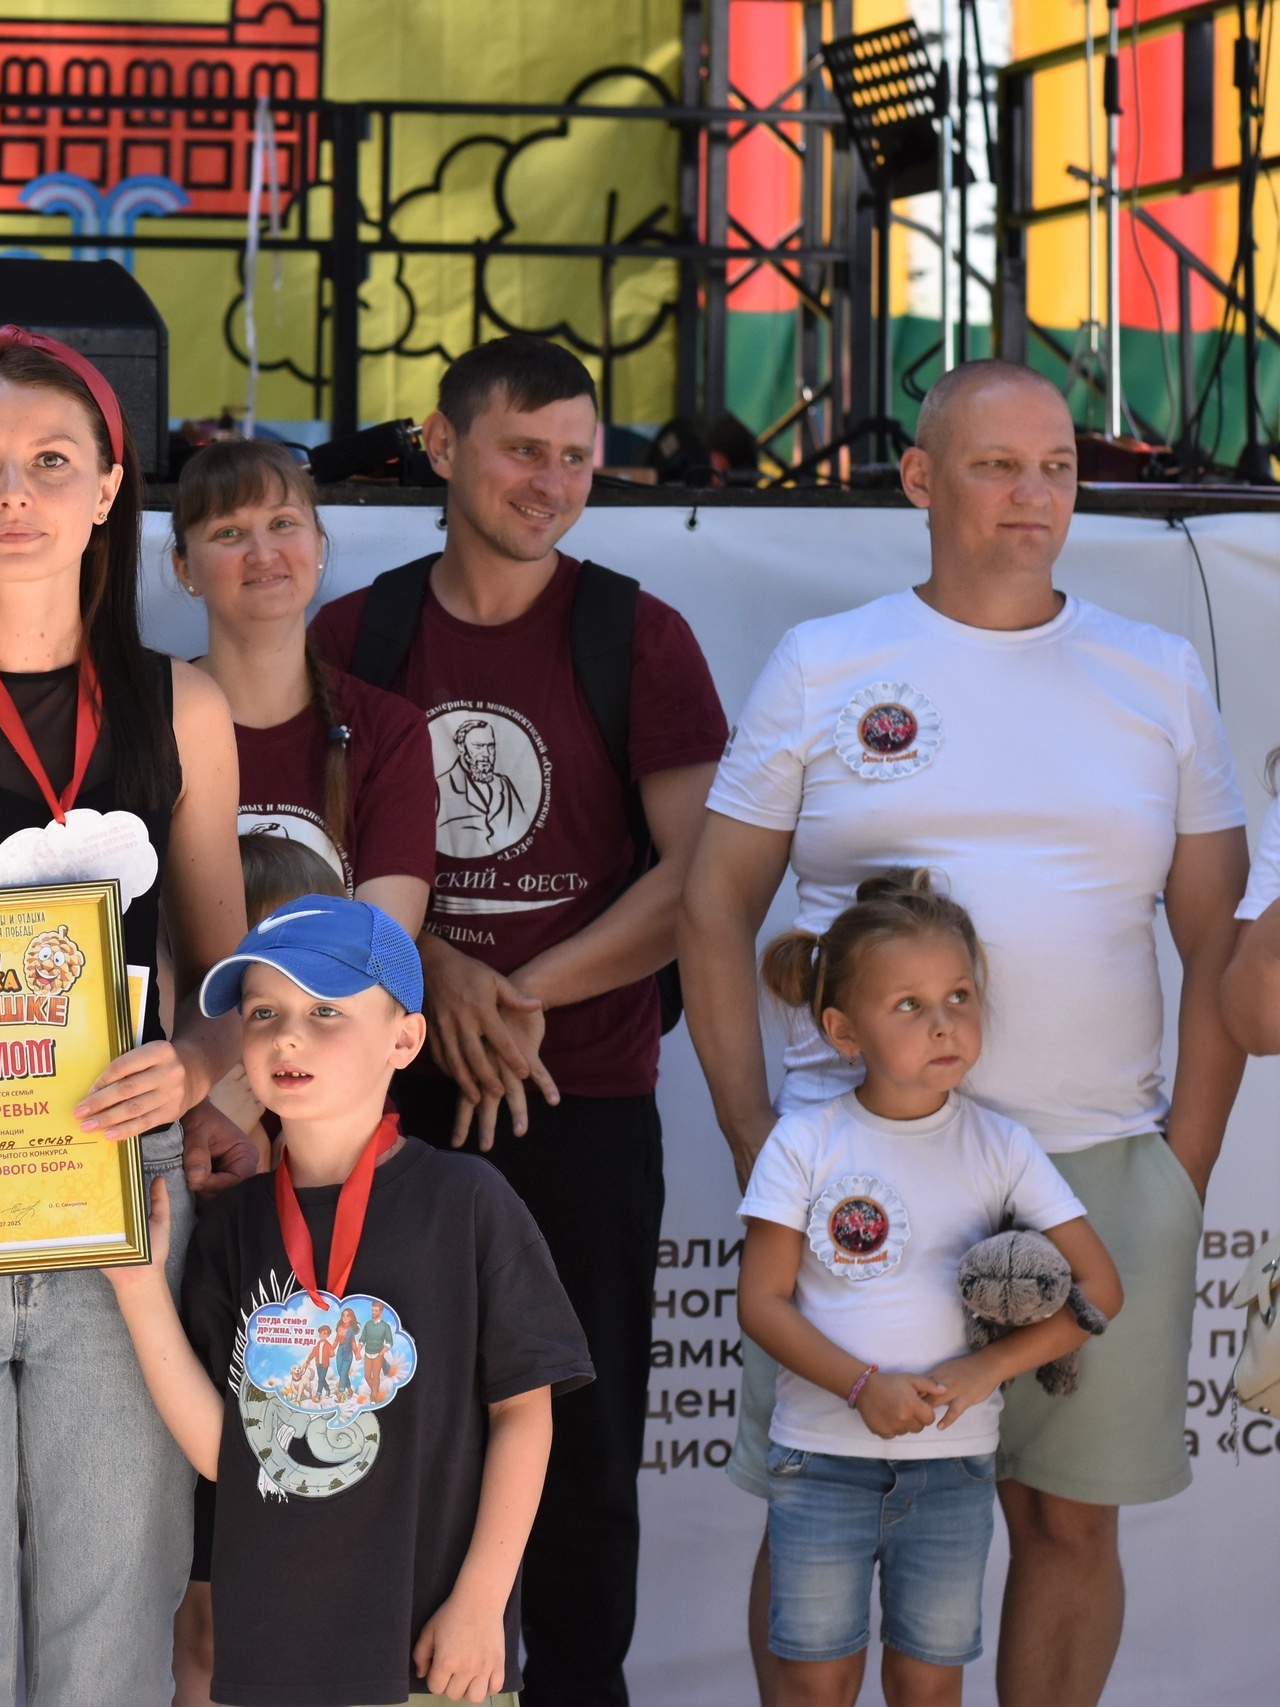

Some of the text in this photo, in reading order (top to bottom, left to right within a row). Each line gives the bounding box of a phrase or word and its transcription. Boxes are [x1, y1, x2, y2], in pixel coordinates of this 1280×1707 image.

[517, 873, 588, 892] ФЕСТ»
[9, 914, 14, 924] И
[18, 912, 46, 924] ОТДЫХА
[5, 925, 34, 937] ПОБЕДЫ
[11, 1089, 34, 1097] СЕМЬЯ
[29, 1148, 68, 1158] КОНКУРСА
[41, 1160, 83, 1173] БОРА»
[257, 1317, 281, 1325] КОГДА
[257, 1327, 292, 1335] ДРУЖНА,
[257, 1336, 292, 1344] СТРАШНА
